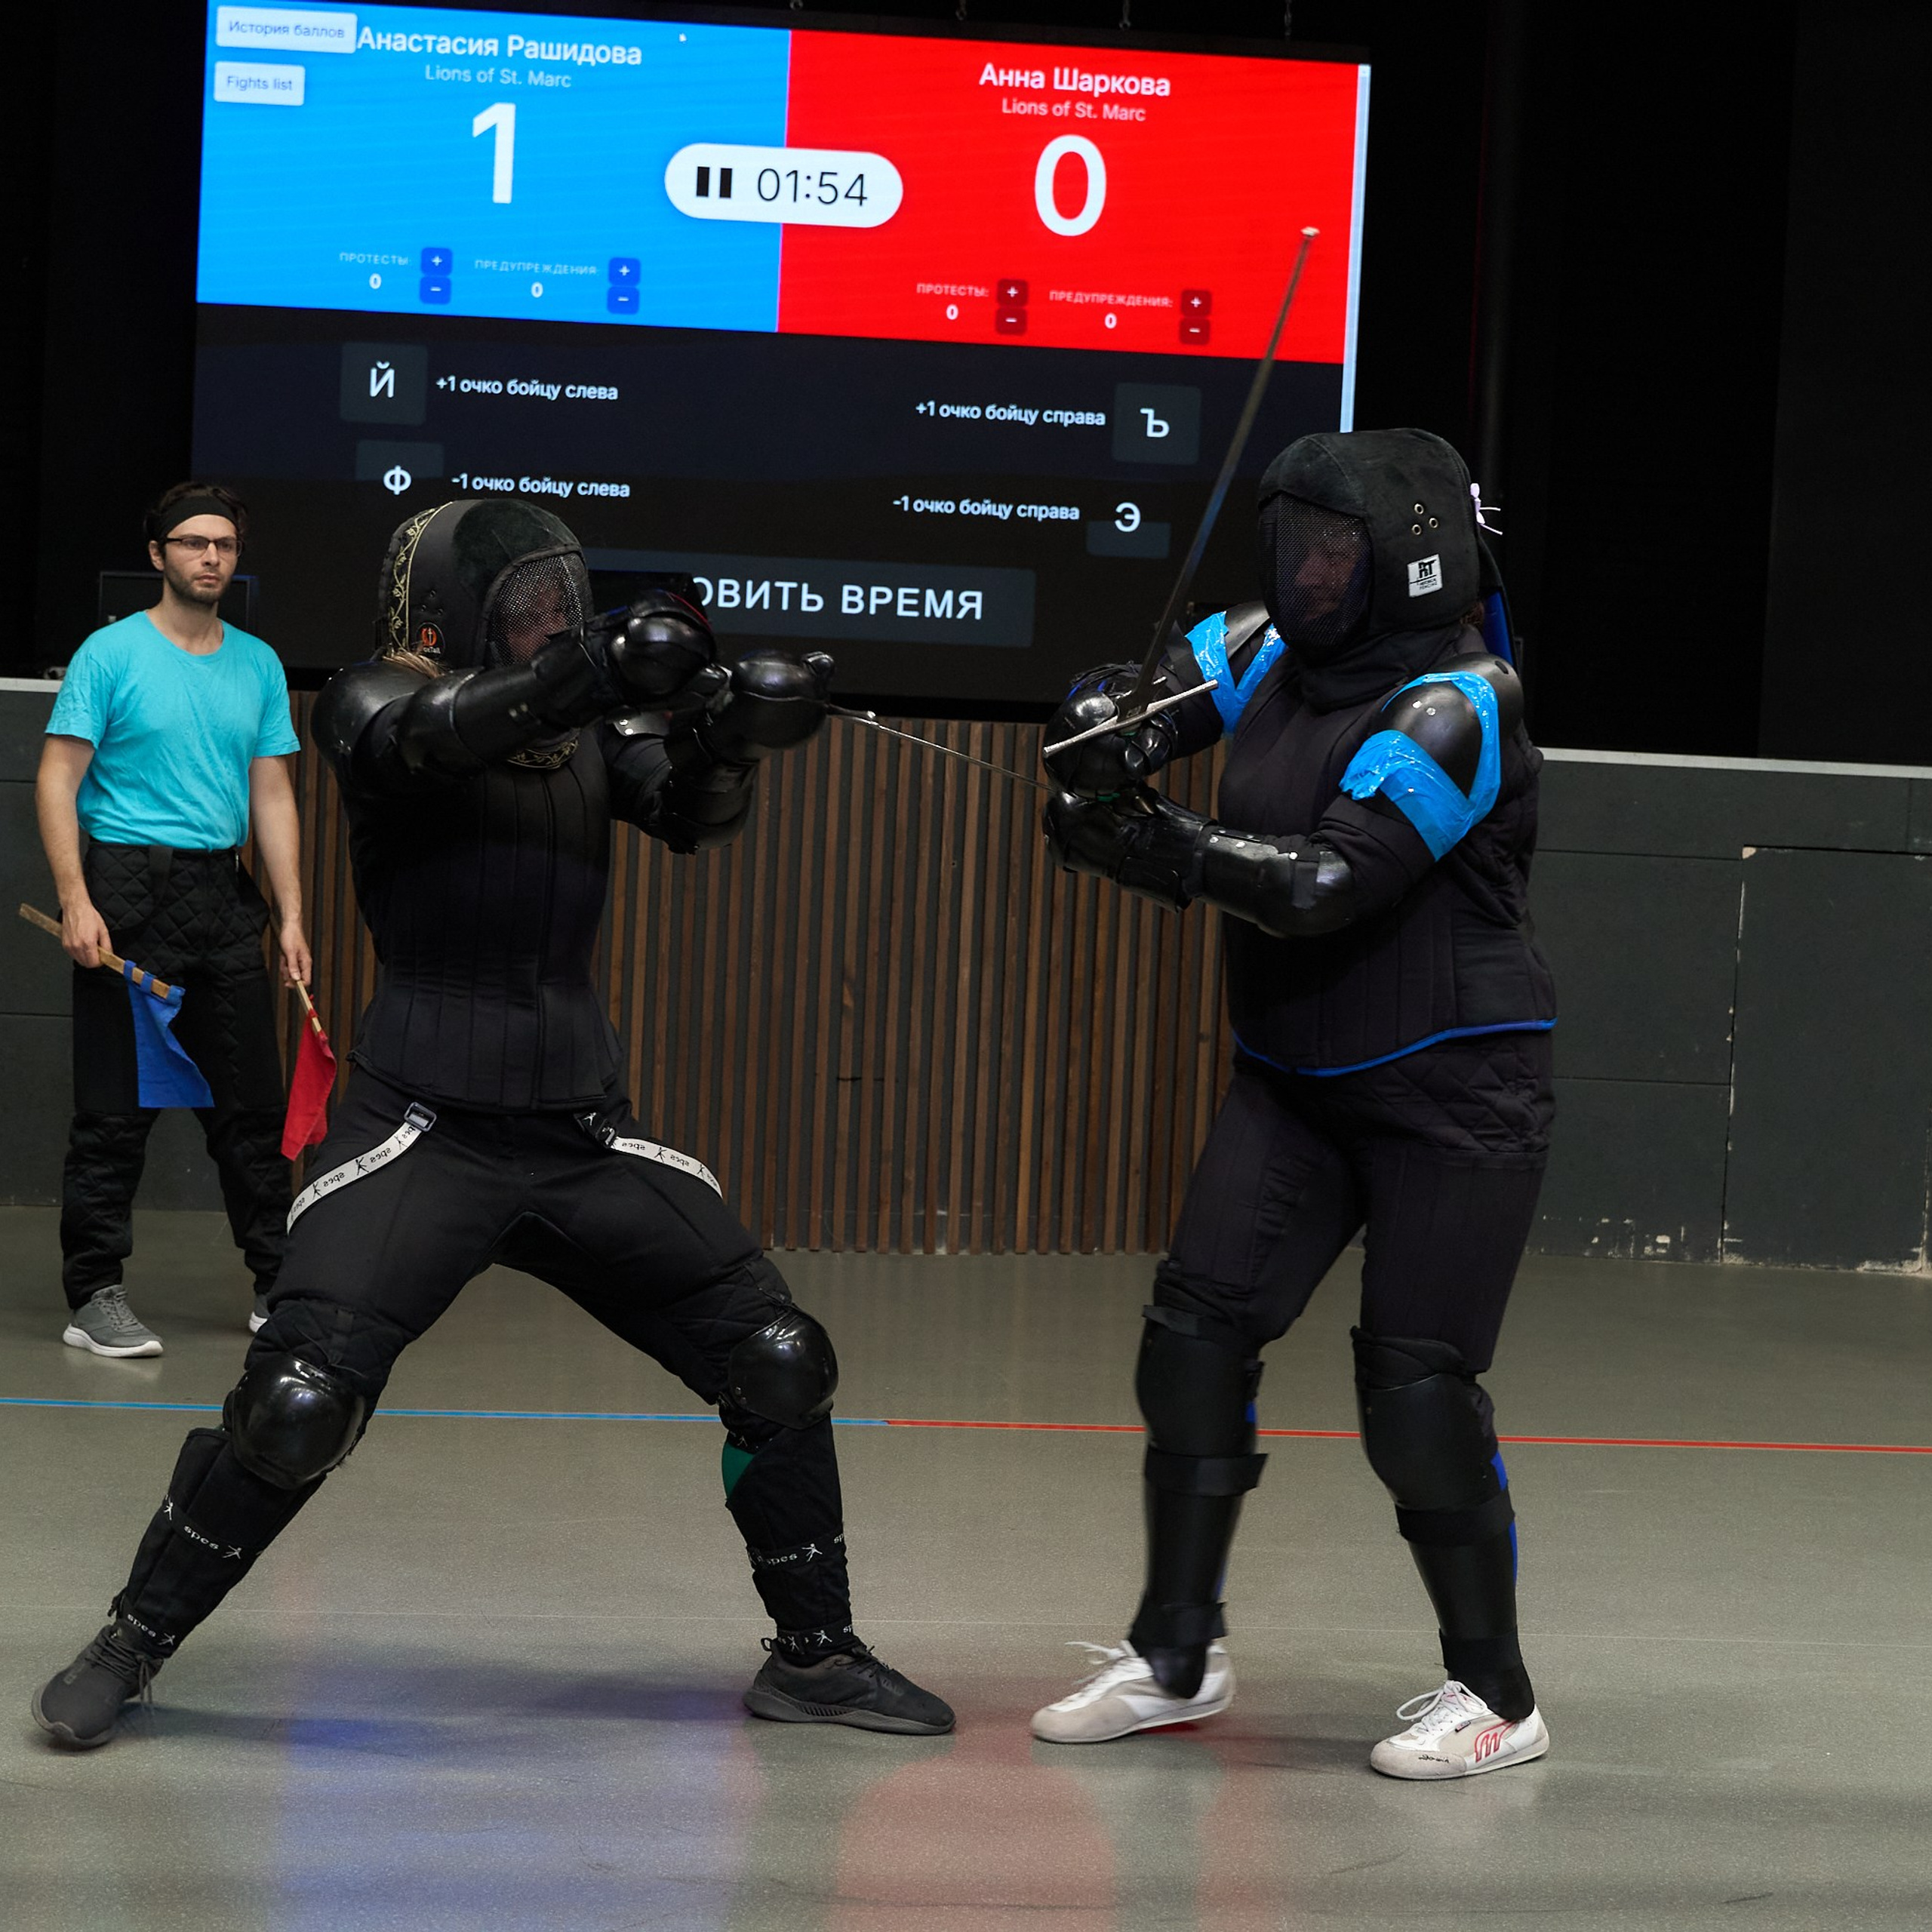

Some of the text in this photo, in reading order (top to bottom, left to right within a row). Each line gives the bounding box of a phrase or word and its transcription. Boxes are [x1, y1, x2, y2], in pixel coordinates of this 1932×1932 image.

[229, 20, 345, 38] История баллов
[357, 26, 643, 66] Анастасия Рашидова
[227, 75, 293, 91] Fights list
[425, 64, 571, 88] Lions of St. Marc
[979, 62, 1171, 98] Анна Шаркова
[1001, 97, 1146, 122] Lions of St. Marc
[472, 102, 515, 205] 1
[757, 168, 868, 207] 01:54
[1034, 134, 1107, 237] 0
[369, 272, 382, 290] 0
[531, 281, 544, 299] 0
[916, 282, 989, 297] ПРОТЕСТЫ:
[946, 303, 959, 321] 0
[1049, 290, 1174, 308] ПРЕДУПРЕЖДЕНИЯ:
[1104, 312, 1118, 330] 0
[369, 361, 395, 398] Й
[435, 374, 619, 401] +1 очко бойцу слева
[915, 401, 1106, 427] +1 очко бойцу справа
[1140, 408, 1170, 438] Ъ
[383, 465, 412, 496] Ф
[451, 473, 631, 499] -1 очко бойцу слева
[892, 495, 1080, 521] -1 очко бойцу справа
[1114, 502, 1141, 532] Э
[841, 584, 983, 621] ВРЕМЯ
